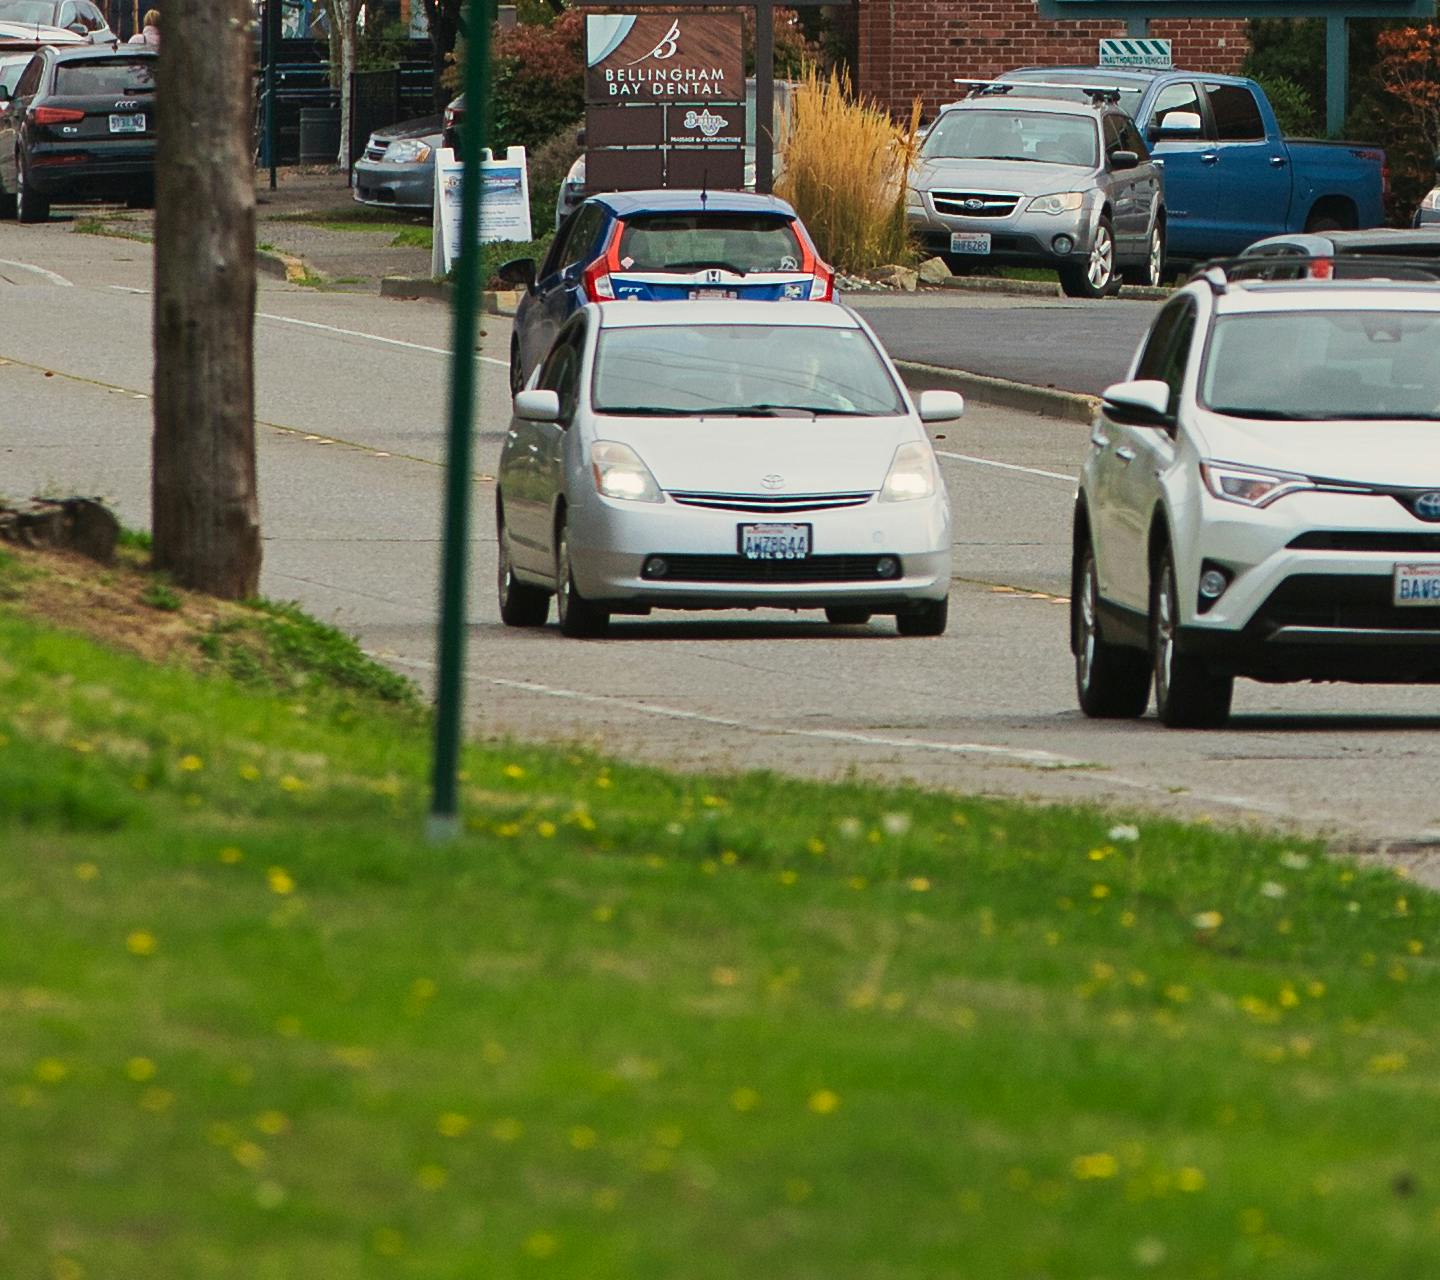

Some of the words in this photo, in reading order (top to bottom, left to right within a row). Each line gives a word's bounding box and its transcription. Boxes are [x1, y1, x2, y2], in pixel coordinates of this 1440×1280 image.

[605, 68, 724, 82] BELLINGHAM
[609, 83, 641, 96] BAY
[653, 82, 722, 96] DENTAL
